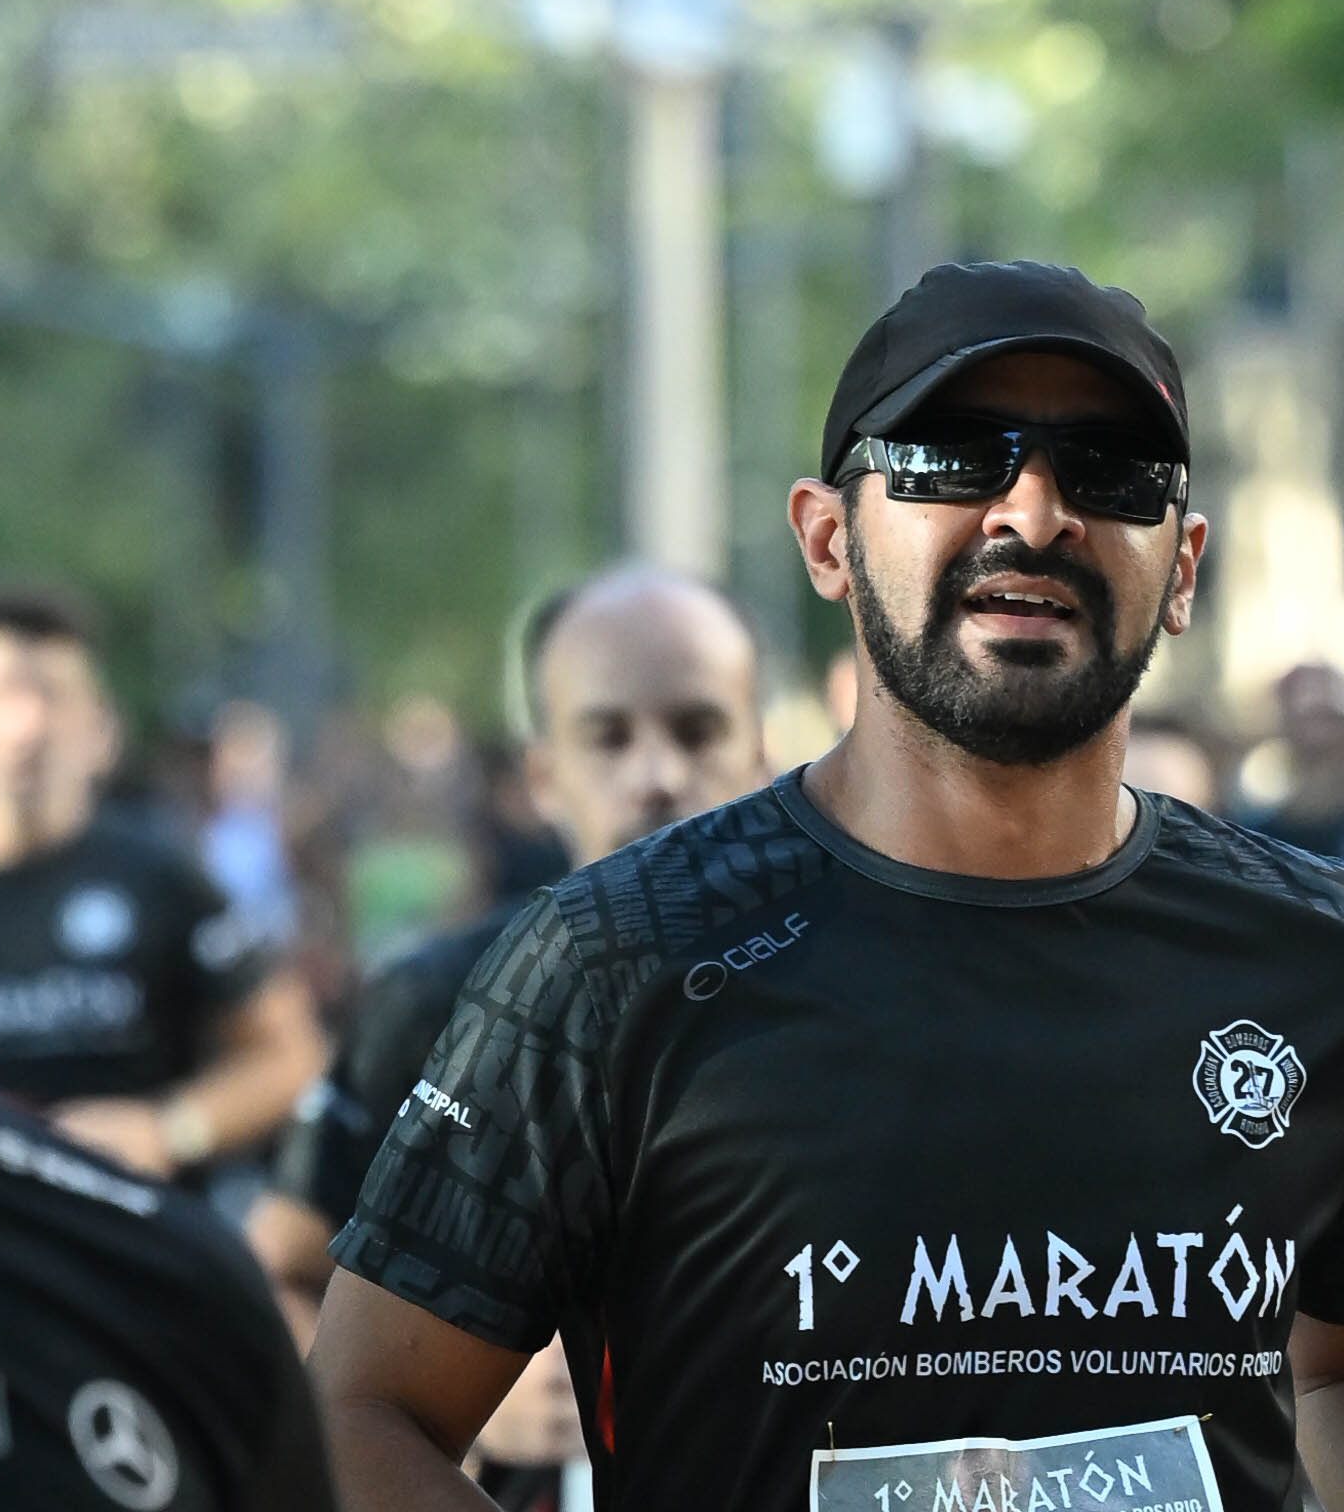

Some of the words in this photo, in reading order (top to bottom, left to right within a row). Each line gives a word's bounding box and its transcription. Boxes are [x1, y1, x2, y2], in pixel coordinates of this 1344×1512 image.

[1231, 1059, 1274, 1100] 27
[900, 1203, 1296, 1326] MARATÓN
[762, 1351, 907, 1386] ASOCIACIÓN
[916, 1349, 1062, 1376] BOMBEROS
[1070, 1349, 1236, 1377] VOLUNTARIOS
